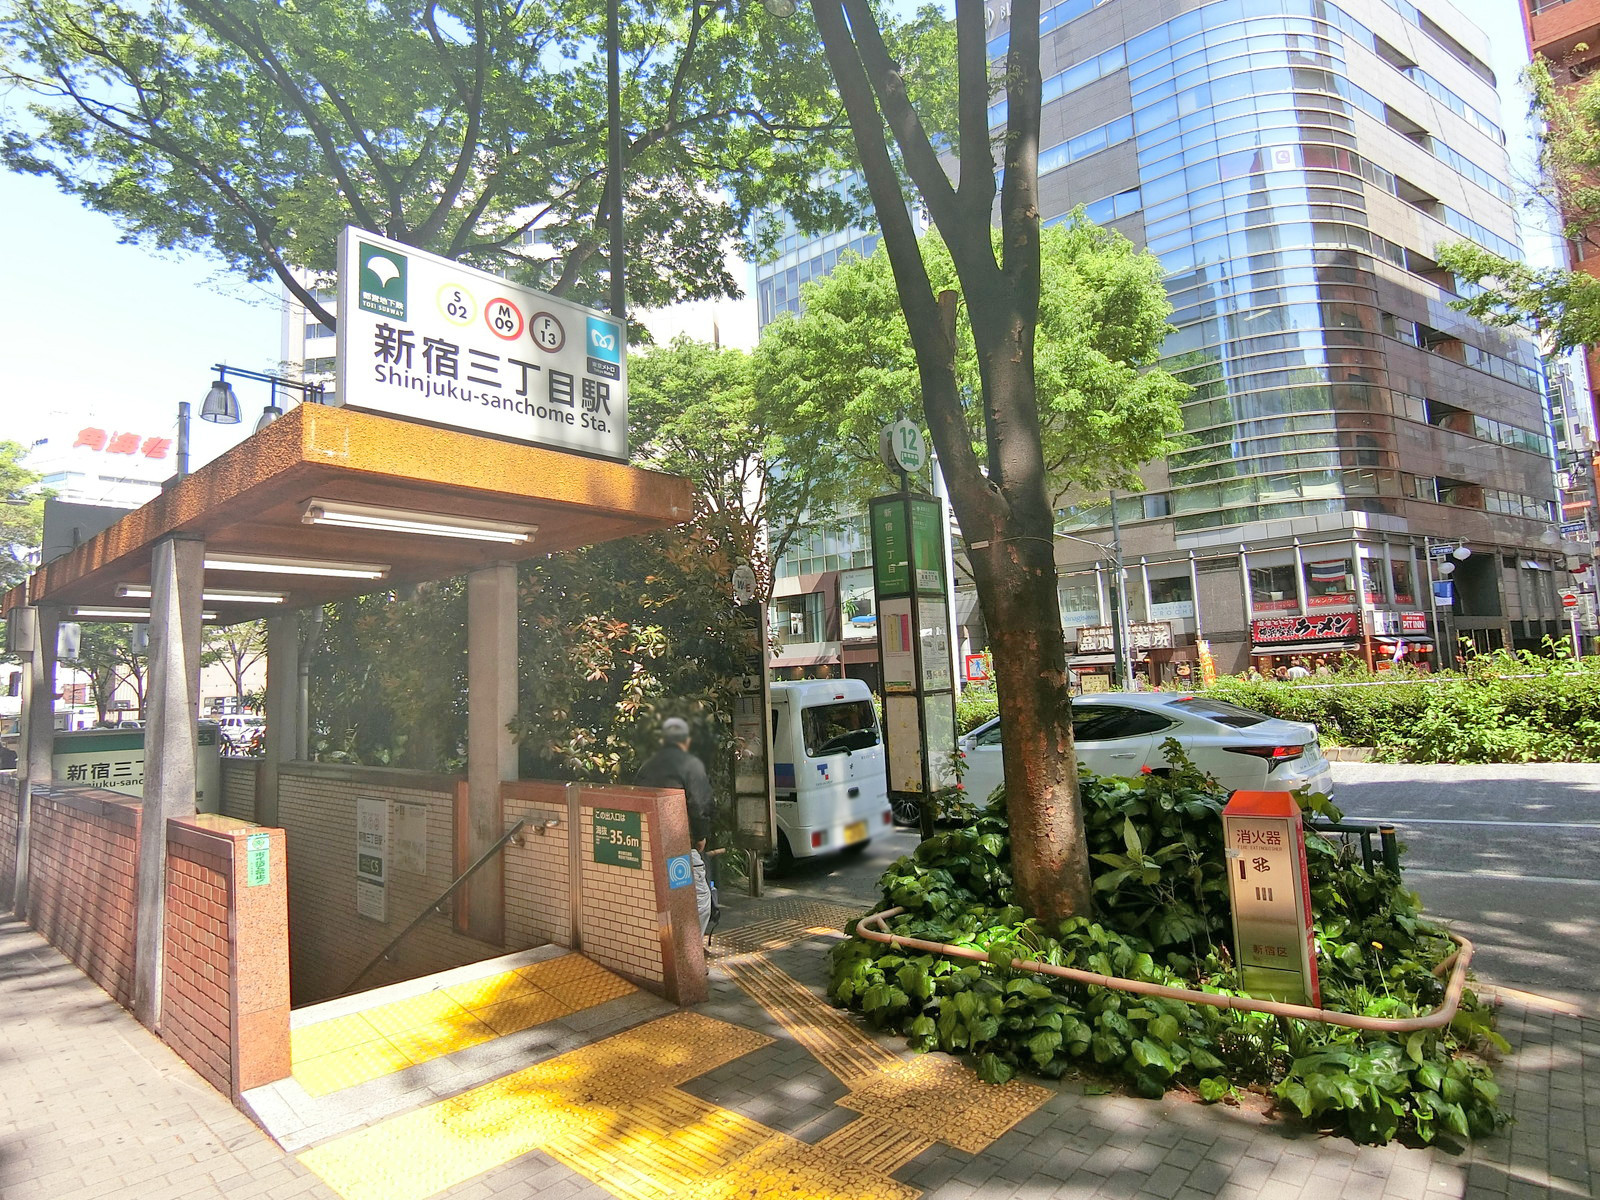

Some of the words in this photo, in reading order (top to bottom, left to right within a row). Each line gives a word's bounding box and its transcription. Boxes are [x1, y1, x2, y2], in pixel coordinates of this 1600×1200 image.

[453, 291, 462, 303] S
[362, 300, 377, 309] TOEI
[378, 305, 404, 317] SUBWAY
[447, 303, 468, 320] 02
[498, 305, 511, 319] M
[494, 316, 514, 333] 09
[544, 319, 551, 330] F
[541, 329, 557, 346] 13
[374, 322, 612, 416] 新宿三丁目駅
[375, 364, 575, 425] Shinjuku-sanchome
[581, 412, 612, 434] Sta.
[899, 426, 918, 451] 12
[882, 507, 896, 574] 新宿三丁目
[1403, 620, 1413, 629] PIT
[1413, 620, 1425, 629] INN
[1080, 631, 1169, 651] 品川麺所
[595, 810, 626, 822] この出入口は
[610, 829, 639, 848] 35.6m
[1236, 829, 1282, 846] 消火器
[1252, 944, 1288, 958] 新宿区
